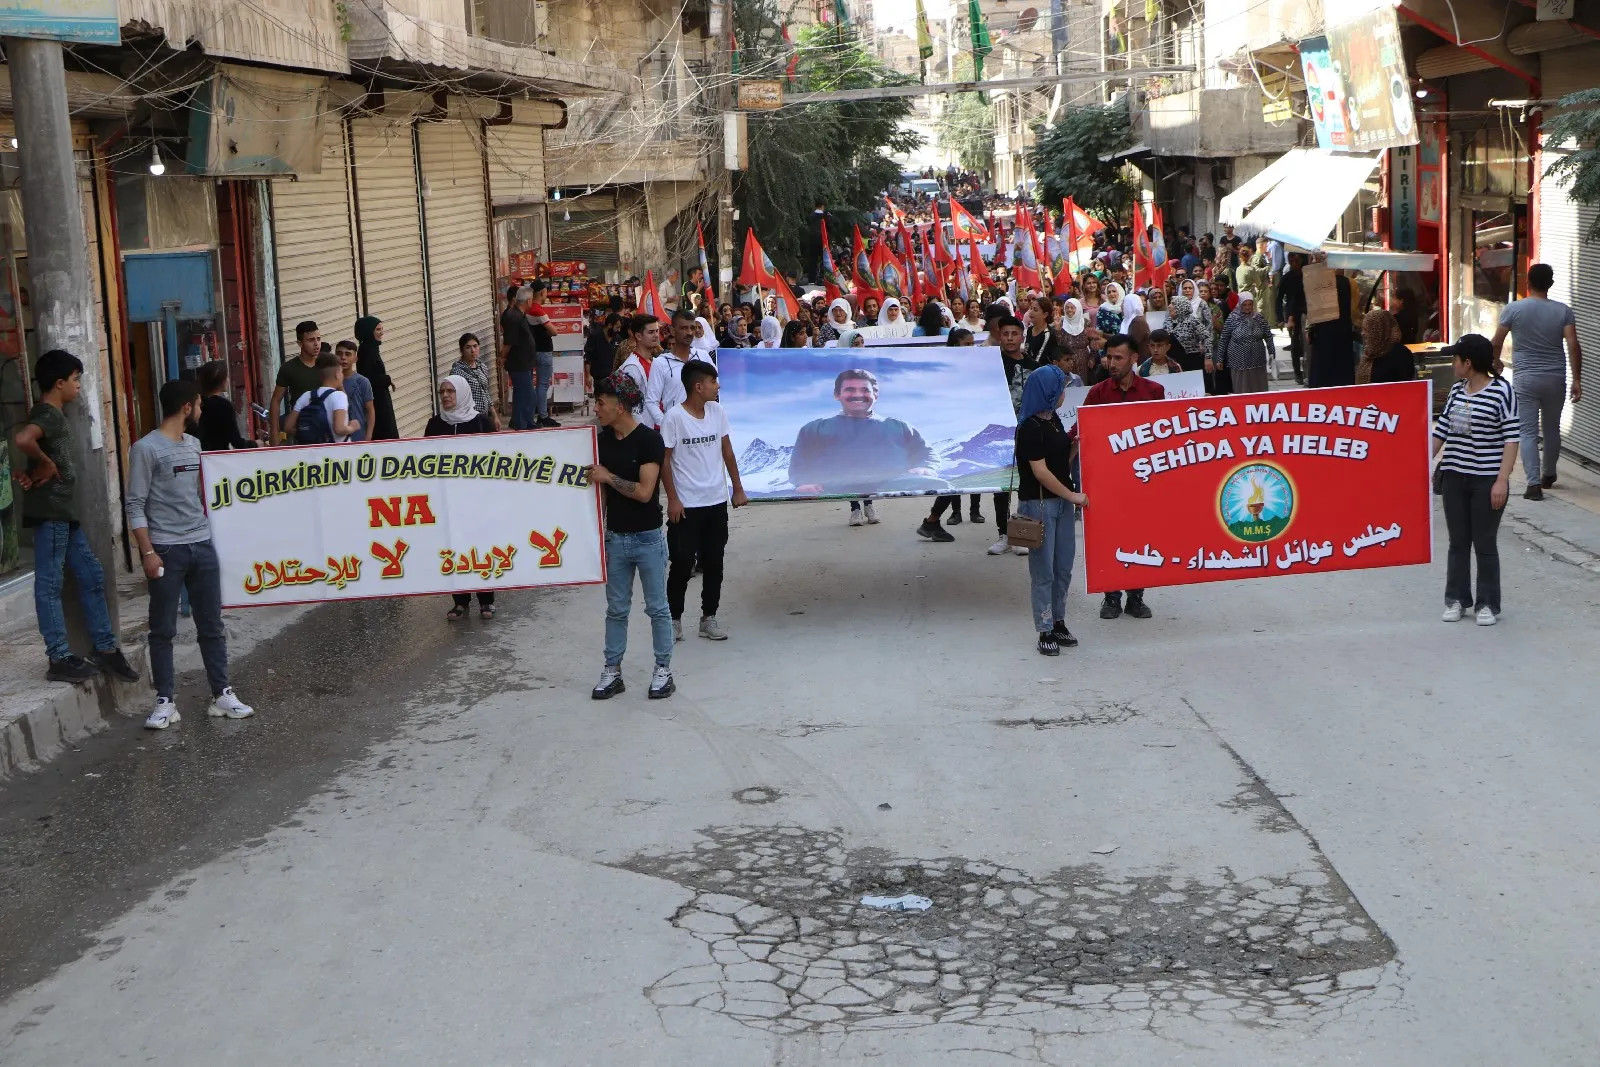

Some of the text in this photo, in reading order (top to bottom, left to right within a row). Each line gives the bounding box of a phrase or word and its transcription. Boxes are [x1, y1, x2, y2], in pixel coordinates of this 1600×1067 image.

[1108, 403, 1399, 454] MECLÎSA MALBATÊN
[357, 453, 375, 480] Û
[1132, 434, 1369, 483] ŞEHÎDA YA HELEB
[368, 494, 436, 528] NA
[1243, 525, 1271, 536] M.M.Ş
[1343, 522, 1402, 557] مجلس
[244, 527, 568, 593] لا لإبادة لا للإحتلال
[1115, 544, 1165, 568] حلب
[1187, 546, 1268, 570] الشهداء
[1276, 539, 1333, 569] عوائل
